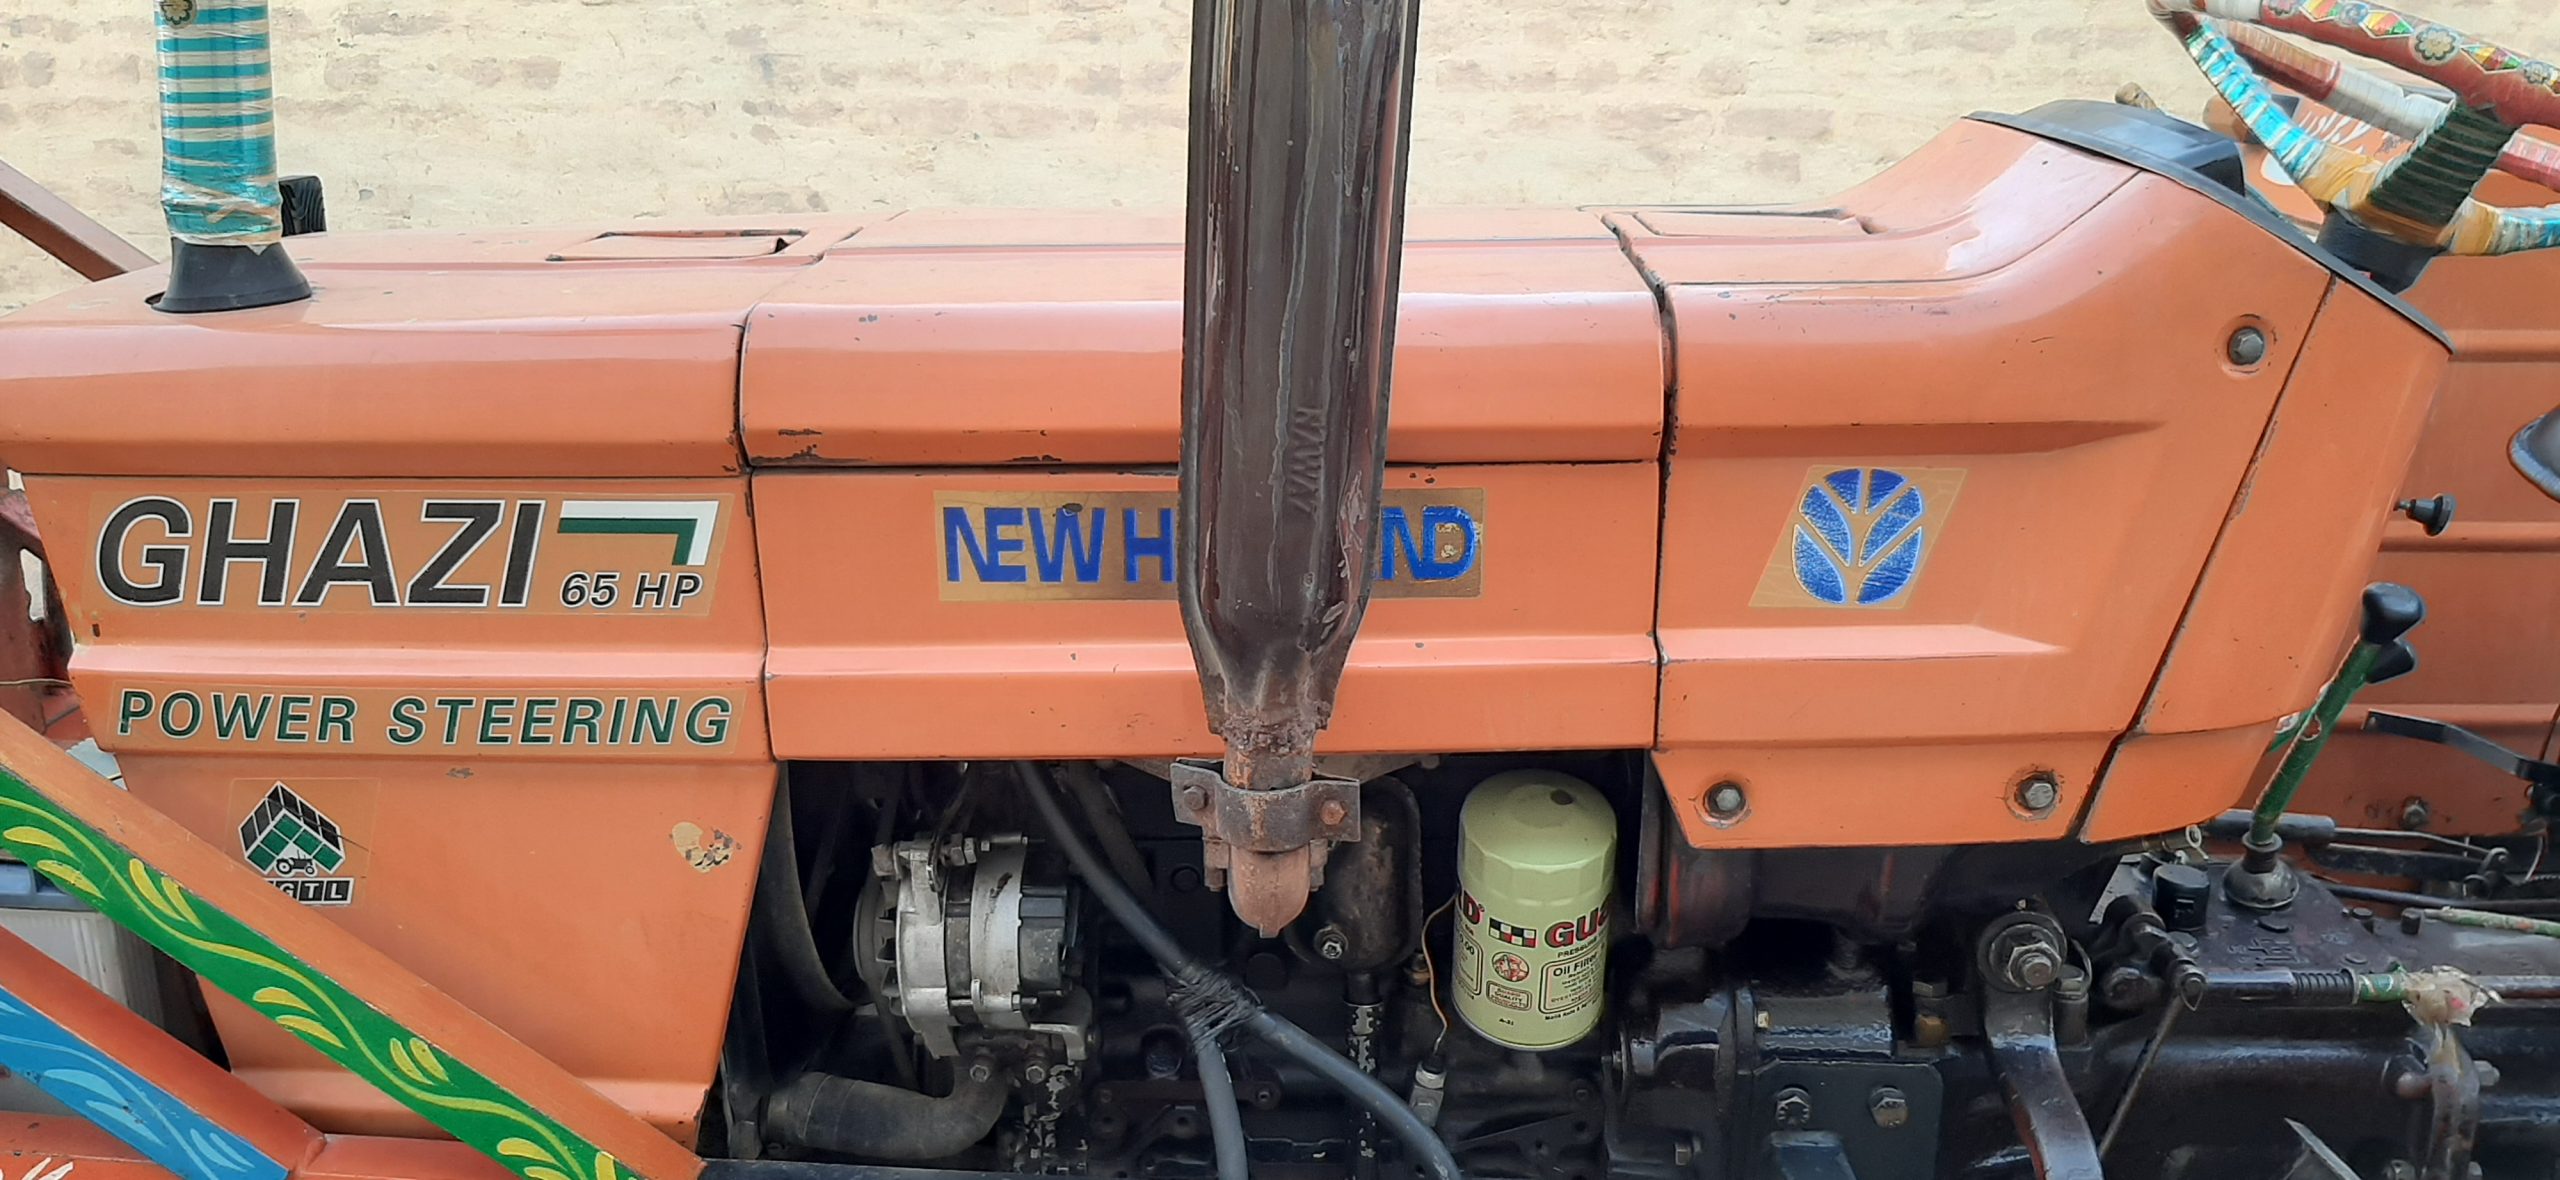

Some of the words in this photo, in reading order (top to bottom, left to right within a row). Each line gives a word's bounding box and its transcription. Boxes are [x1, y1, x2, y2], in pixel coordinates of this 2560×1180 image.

[97, 495, 547, 608] GHAZI
[942, 506, 1106, 583] NEW
[559, 571, 619, 607] 65
[632, 572, 703, 609] HP
[117, 690, 358, 744] POWER
[386, 695, 733, 746] STEERING
[268, 879, 350, 902] GTL
[1553, 965, 1570, 977] Oil
